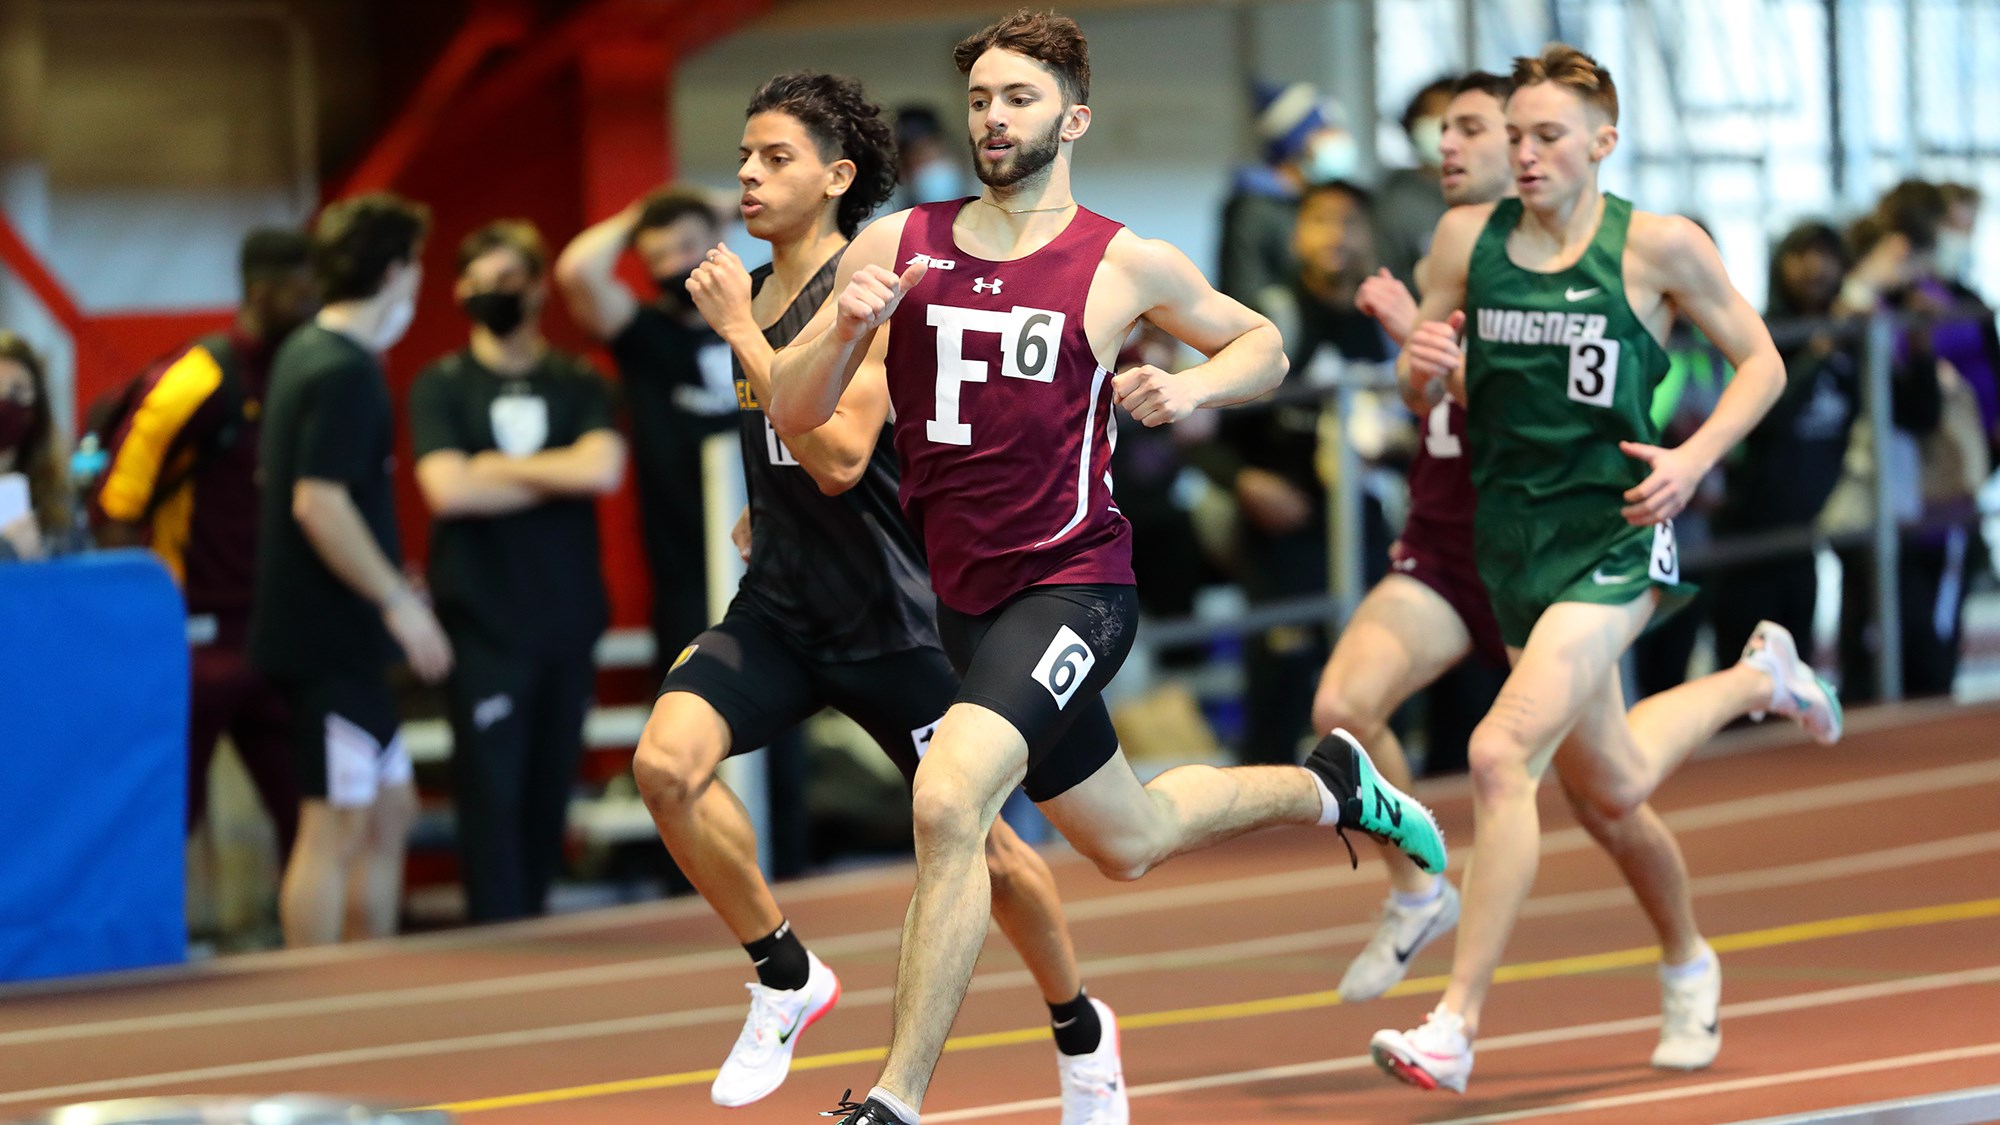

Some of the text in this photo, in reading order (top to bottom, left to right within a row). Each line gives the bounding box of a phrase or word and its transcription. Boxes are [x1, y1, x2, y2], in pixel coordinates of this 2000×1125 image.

[1016, 313, 1052, 376] 6
[1476, 308, 1608, 345] WAGNER
[926, 304, 1011, 445] F
[1575, 345, 1606, 397] 3
[1048, 643, 1089, 696] 6
